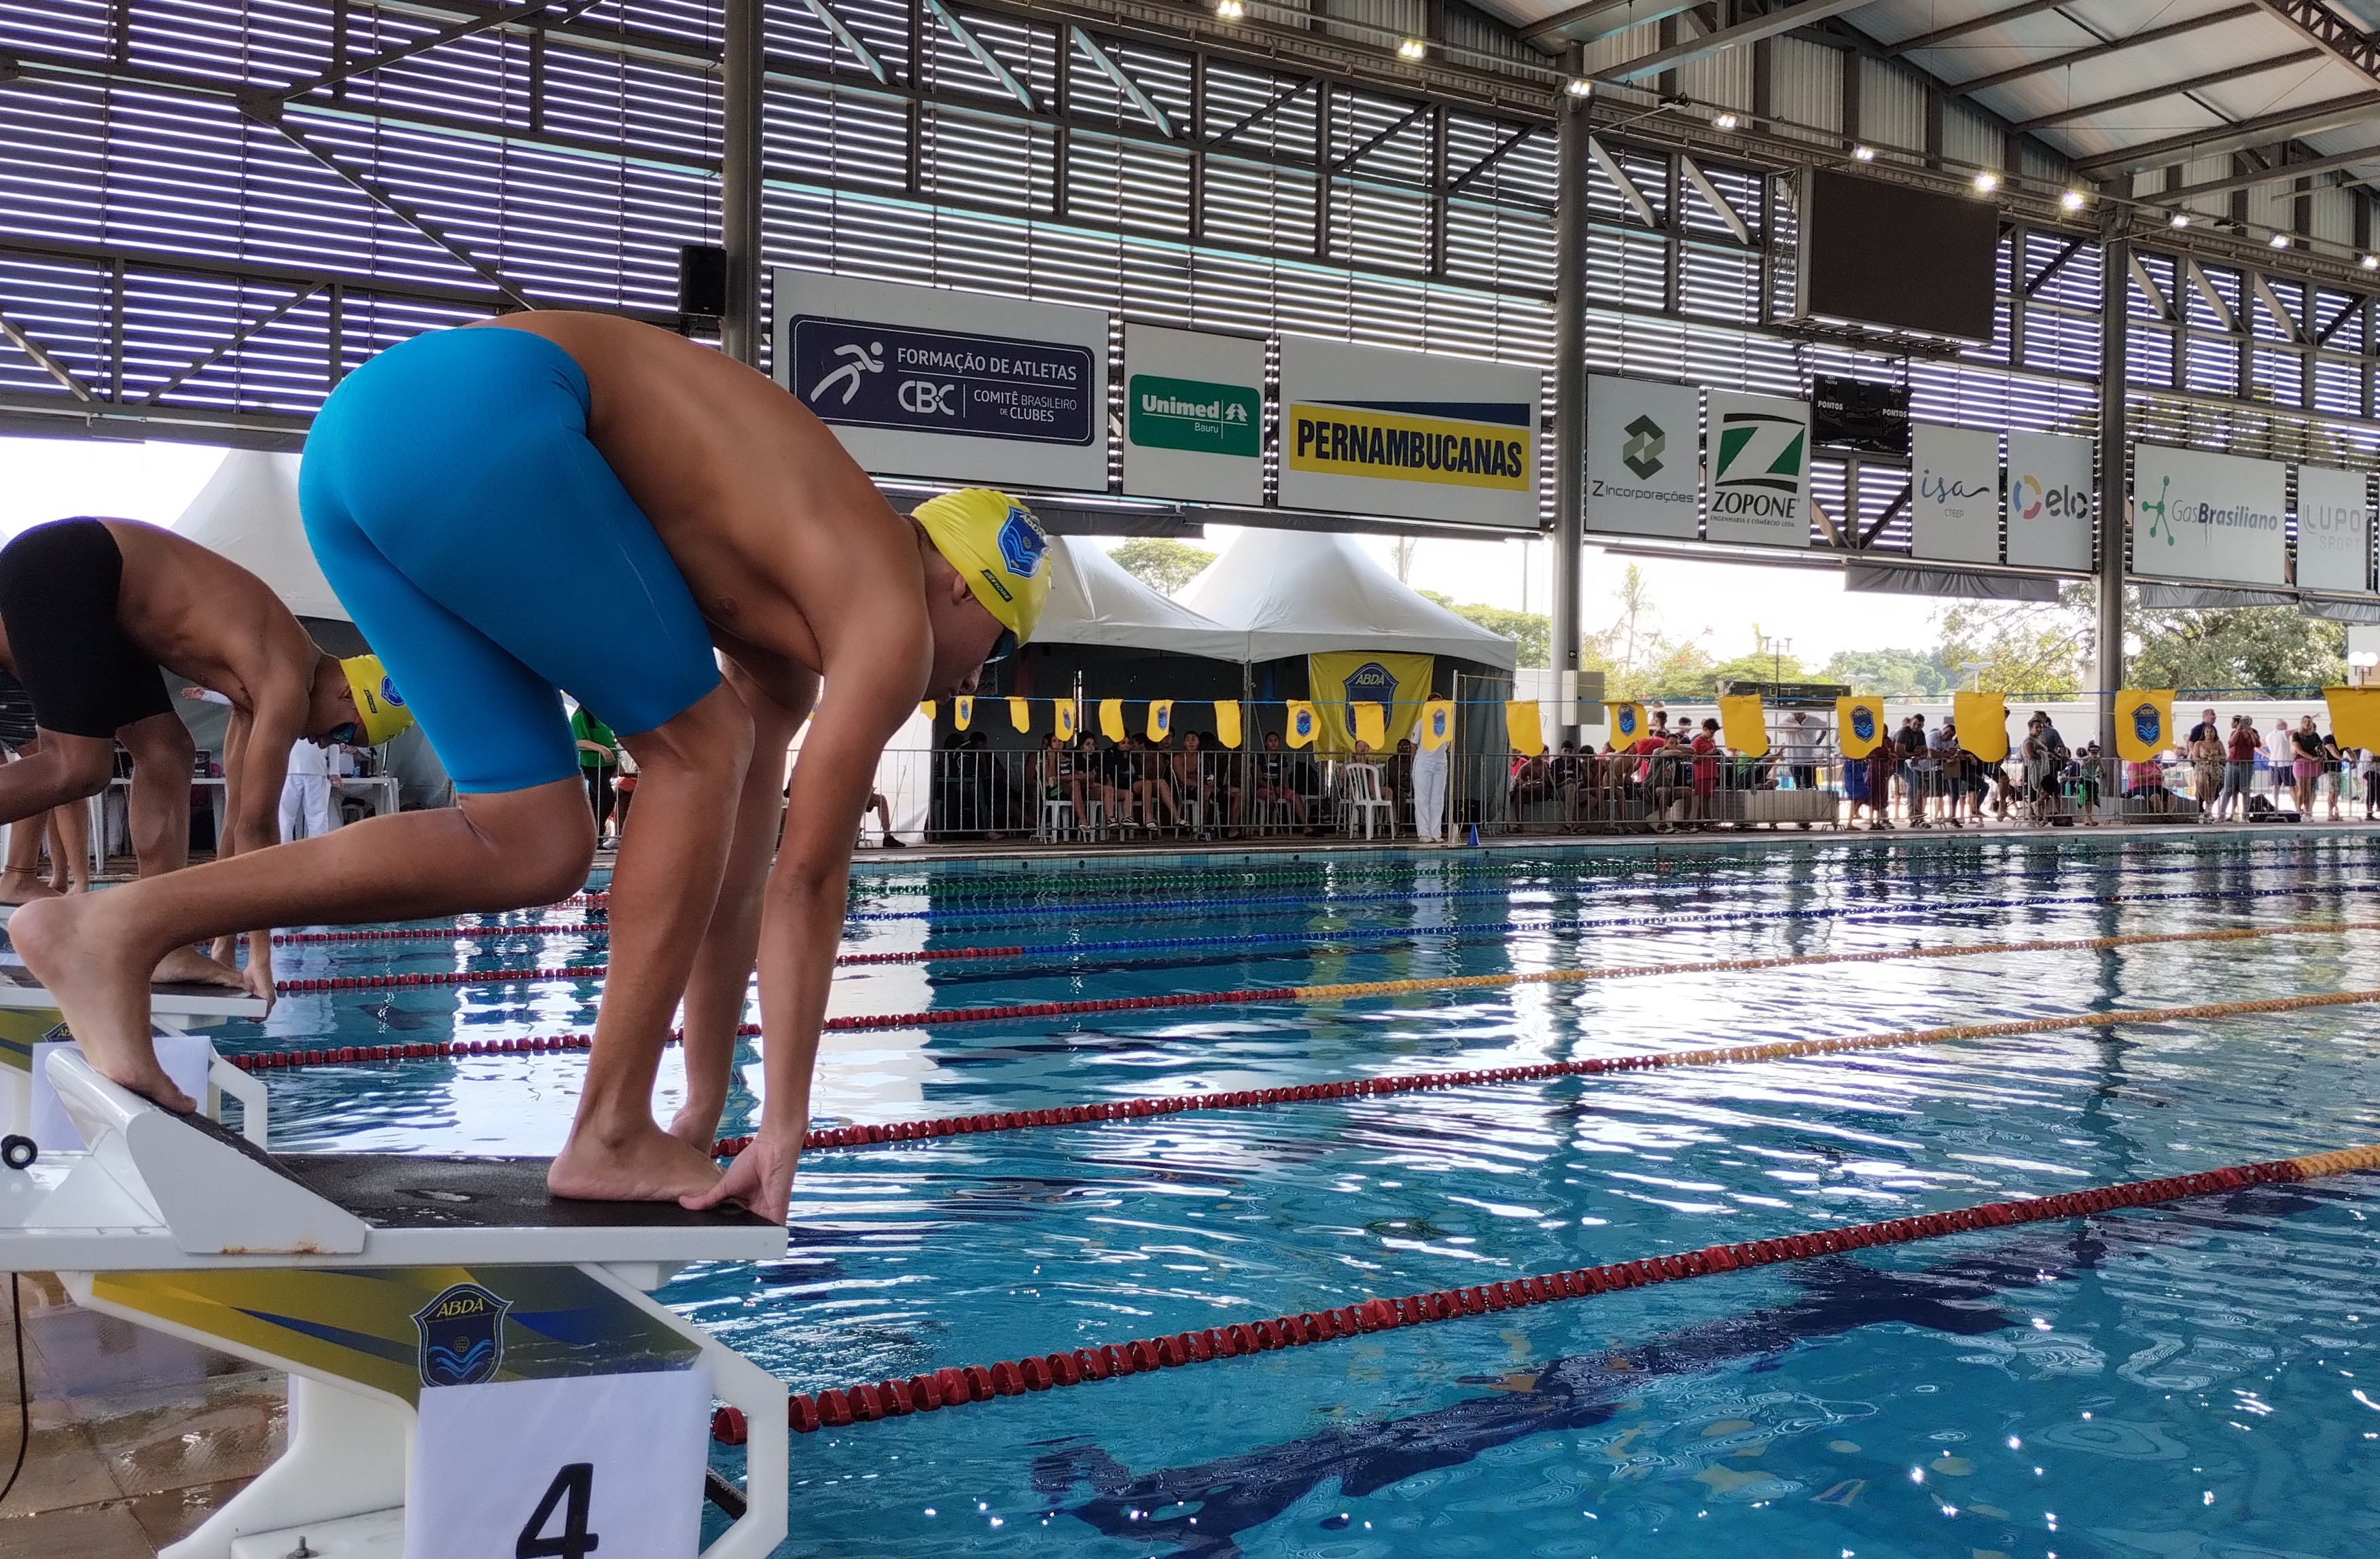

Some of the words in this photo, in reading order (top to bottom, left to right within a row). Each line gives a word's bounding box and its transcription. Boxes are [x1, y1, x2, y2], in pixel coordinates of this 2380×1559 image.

[898, 347, 986, 373] FORMAÇÃO
[990, 357, 1010, 373] DE
[1013, 360, 1077, 380] ATLETAS
[898, 380, 955, 416] CBC
[974, 389, 1018, 405] COMITÊ
[1021, 395, 1077, 410] BRASILEIRO
[1142, 394, 1220, 418] Unimed
[1817, 400, 1843, 410] PONTOS
[1010, 408, 1054, 422] CLUBES
[1882, 408, 1907, 418] PONTOS
[1194, 422, 1219, 433] Bauru
[1297, 418, 1523, 478] PERNAMBUCANAS
[1921, 469, 1990, 504] isa
[1711, 491, 1797, 518] ZOPONE
[2045, 484, 2088, 519] elo
[1710, 514, 1745, 524] ENGENHARIA
[1751, 518, 1780, 526] COMÉRCIO
[1944, 508, 1964, 518] CTEEP
[2172, 499, 2278, 531] GasBrasiliano
[2303, 503, 2361, 535] LUPO
[2320, 535, 2361, 553] SPORT
[1355, 673, 1385, 685] ABDA
[436, 1297, 484, 1317] ABDA
[515, 1462, 599, 1559] 4
